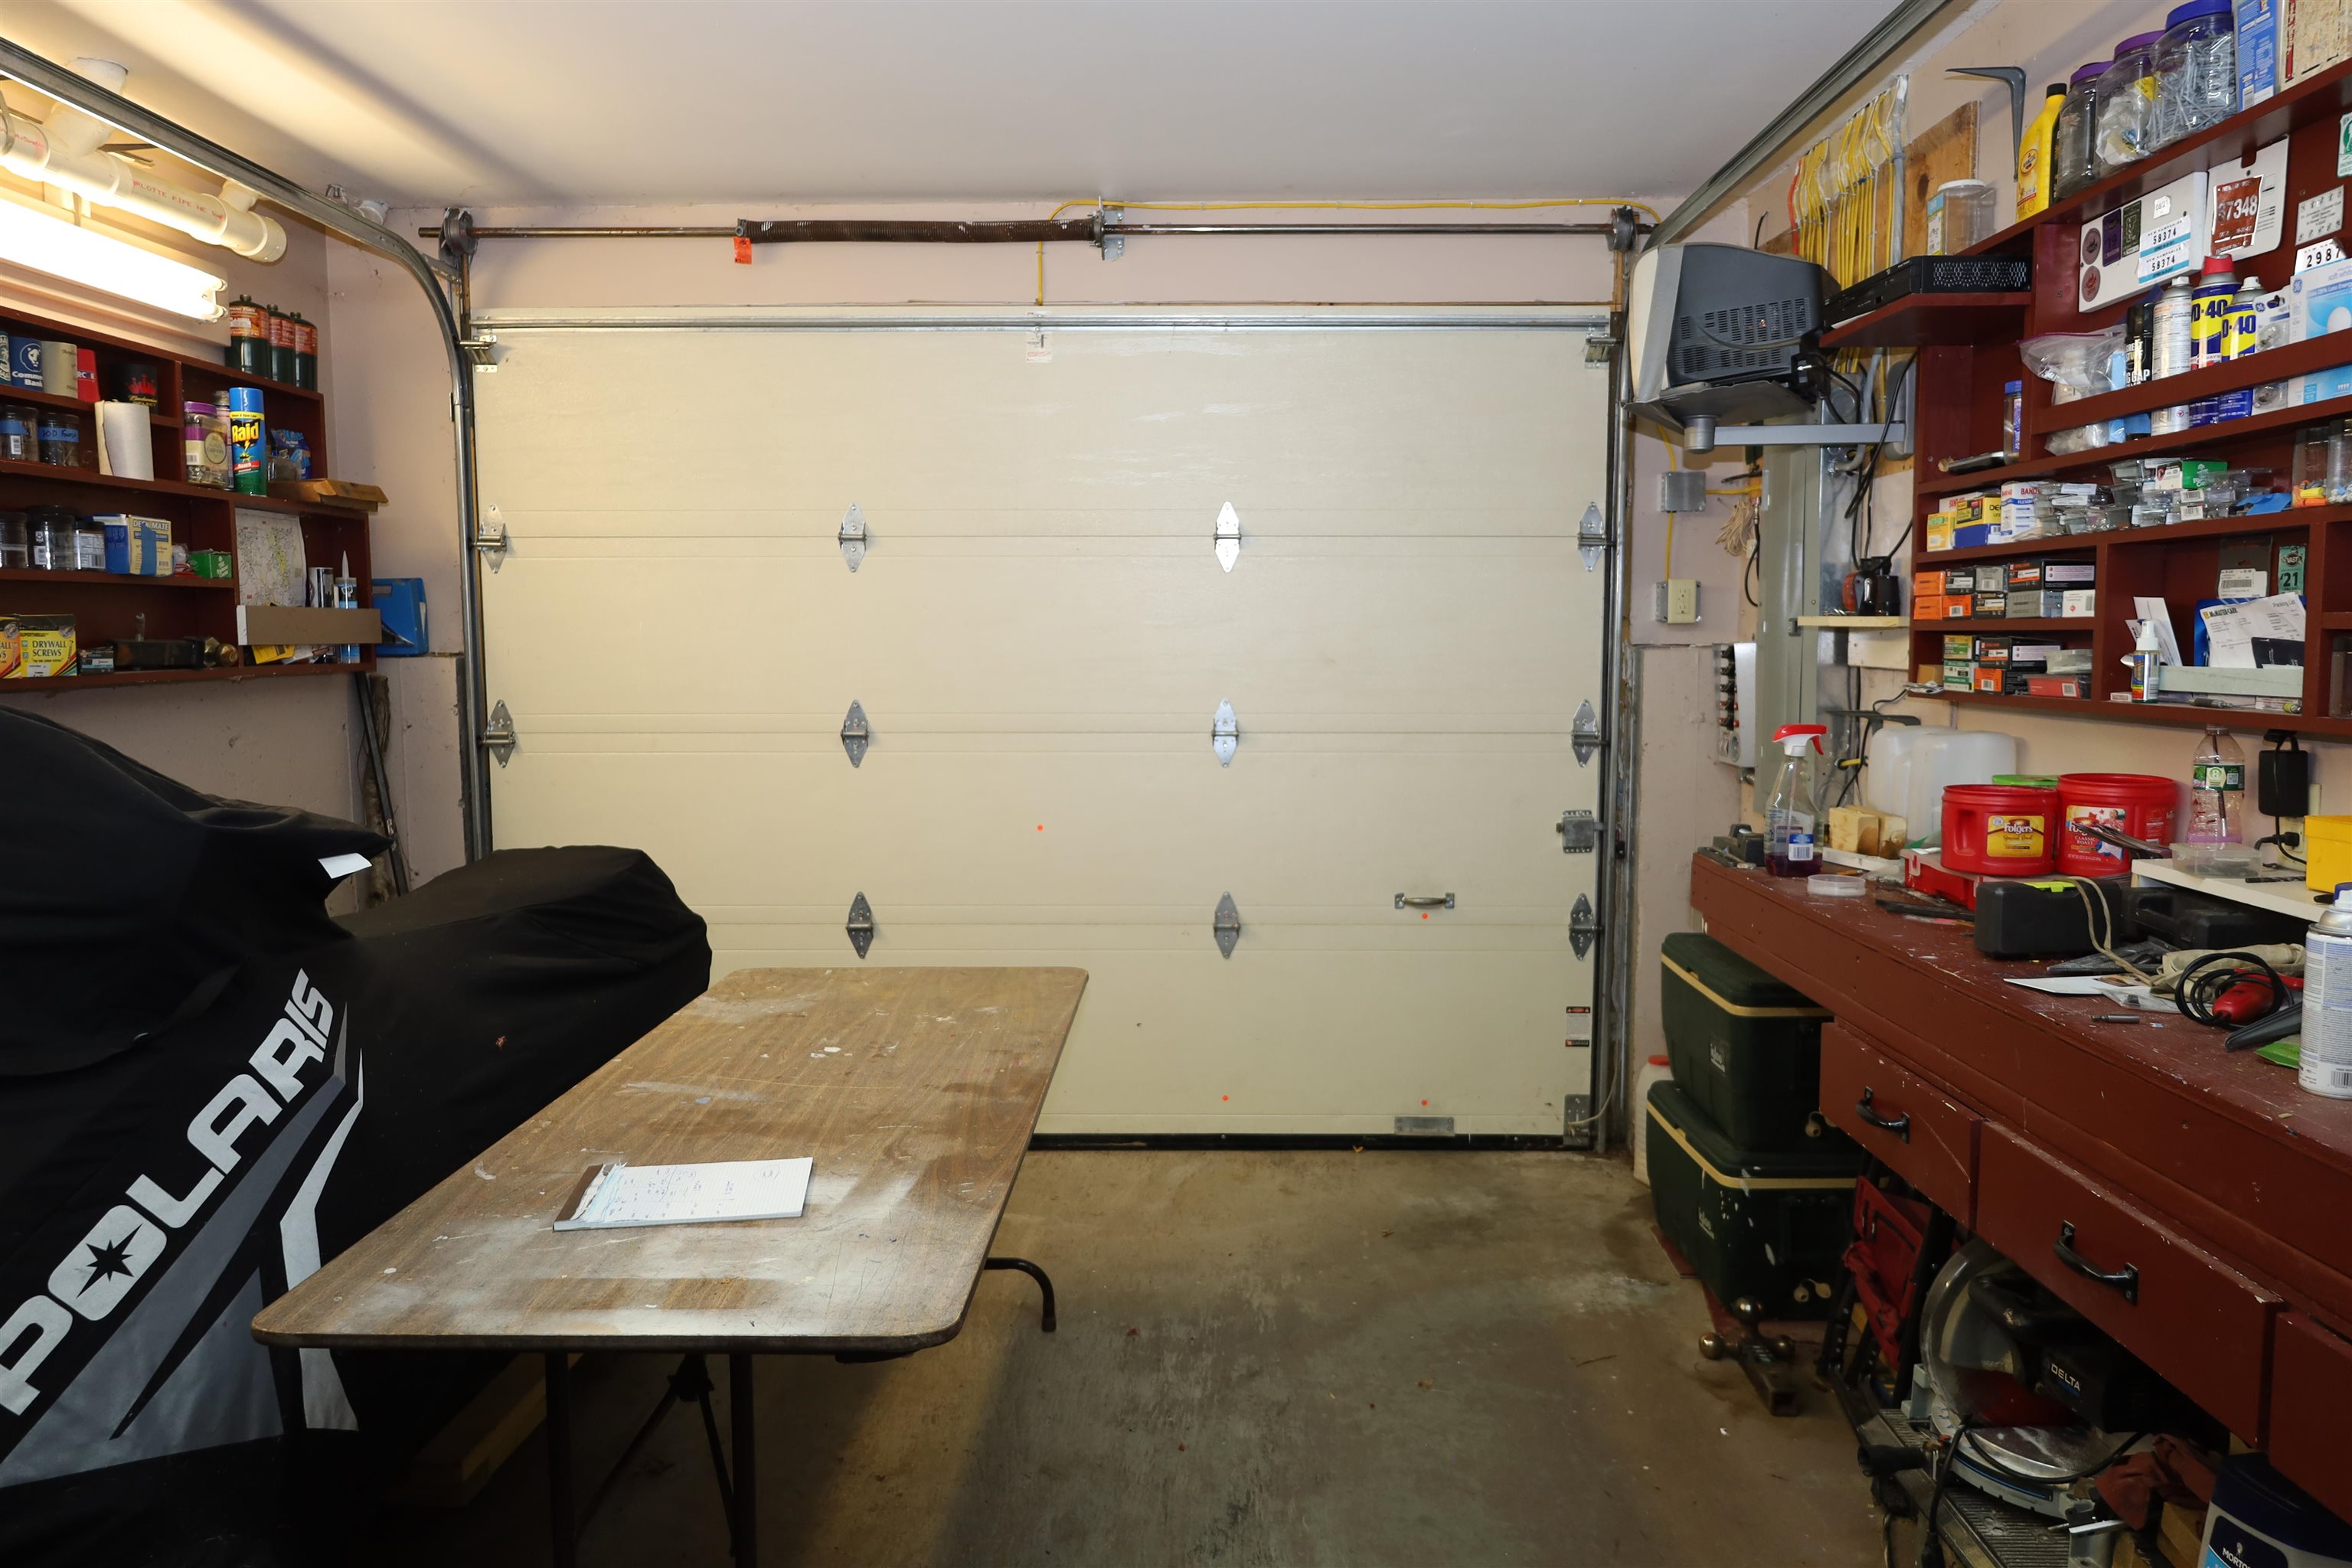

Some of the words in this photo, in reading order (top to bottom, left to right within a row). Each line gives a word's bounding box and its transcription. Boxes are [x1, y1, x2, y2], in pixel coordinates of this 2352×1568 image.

[2153, 227, 2177, 244] 58374
[2151, 255, 2175, 272] 58374
[2132, 369, 2151, 383] GAP
[231, 422, 259, 443] Raid
[153, 521, 169, 531] MATE
[32, 640, 67, 648] DRYWALL
[2004, 822, 2033, 835] Folgers
[0, 968, 334, 1416] POLARIS
[2051, 1363, 2081, 1392] DELTA
